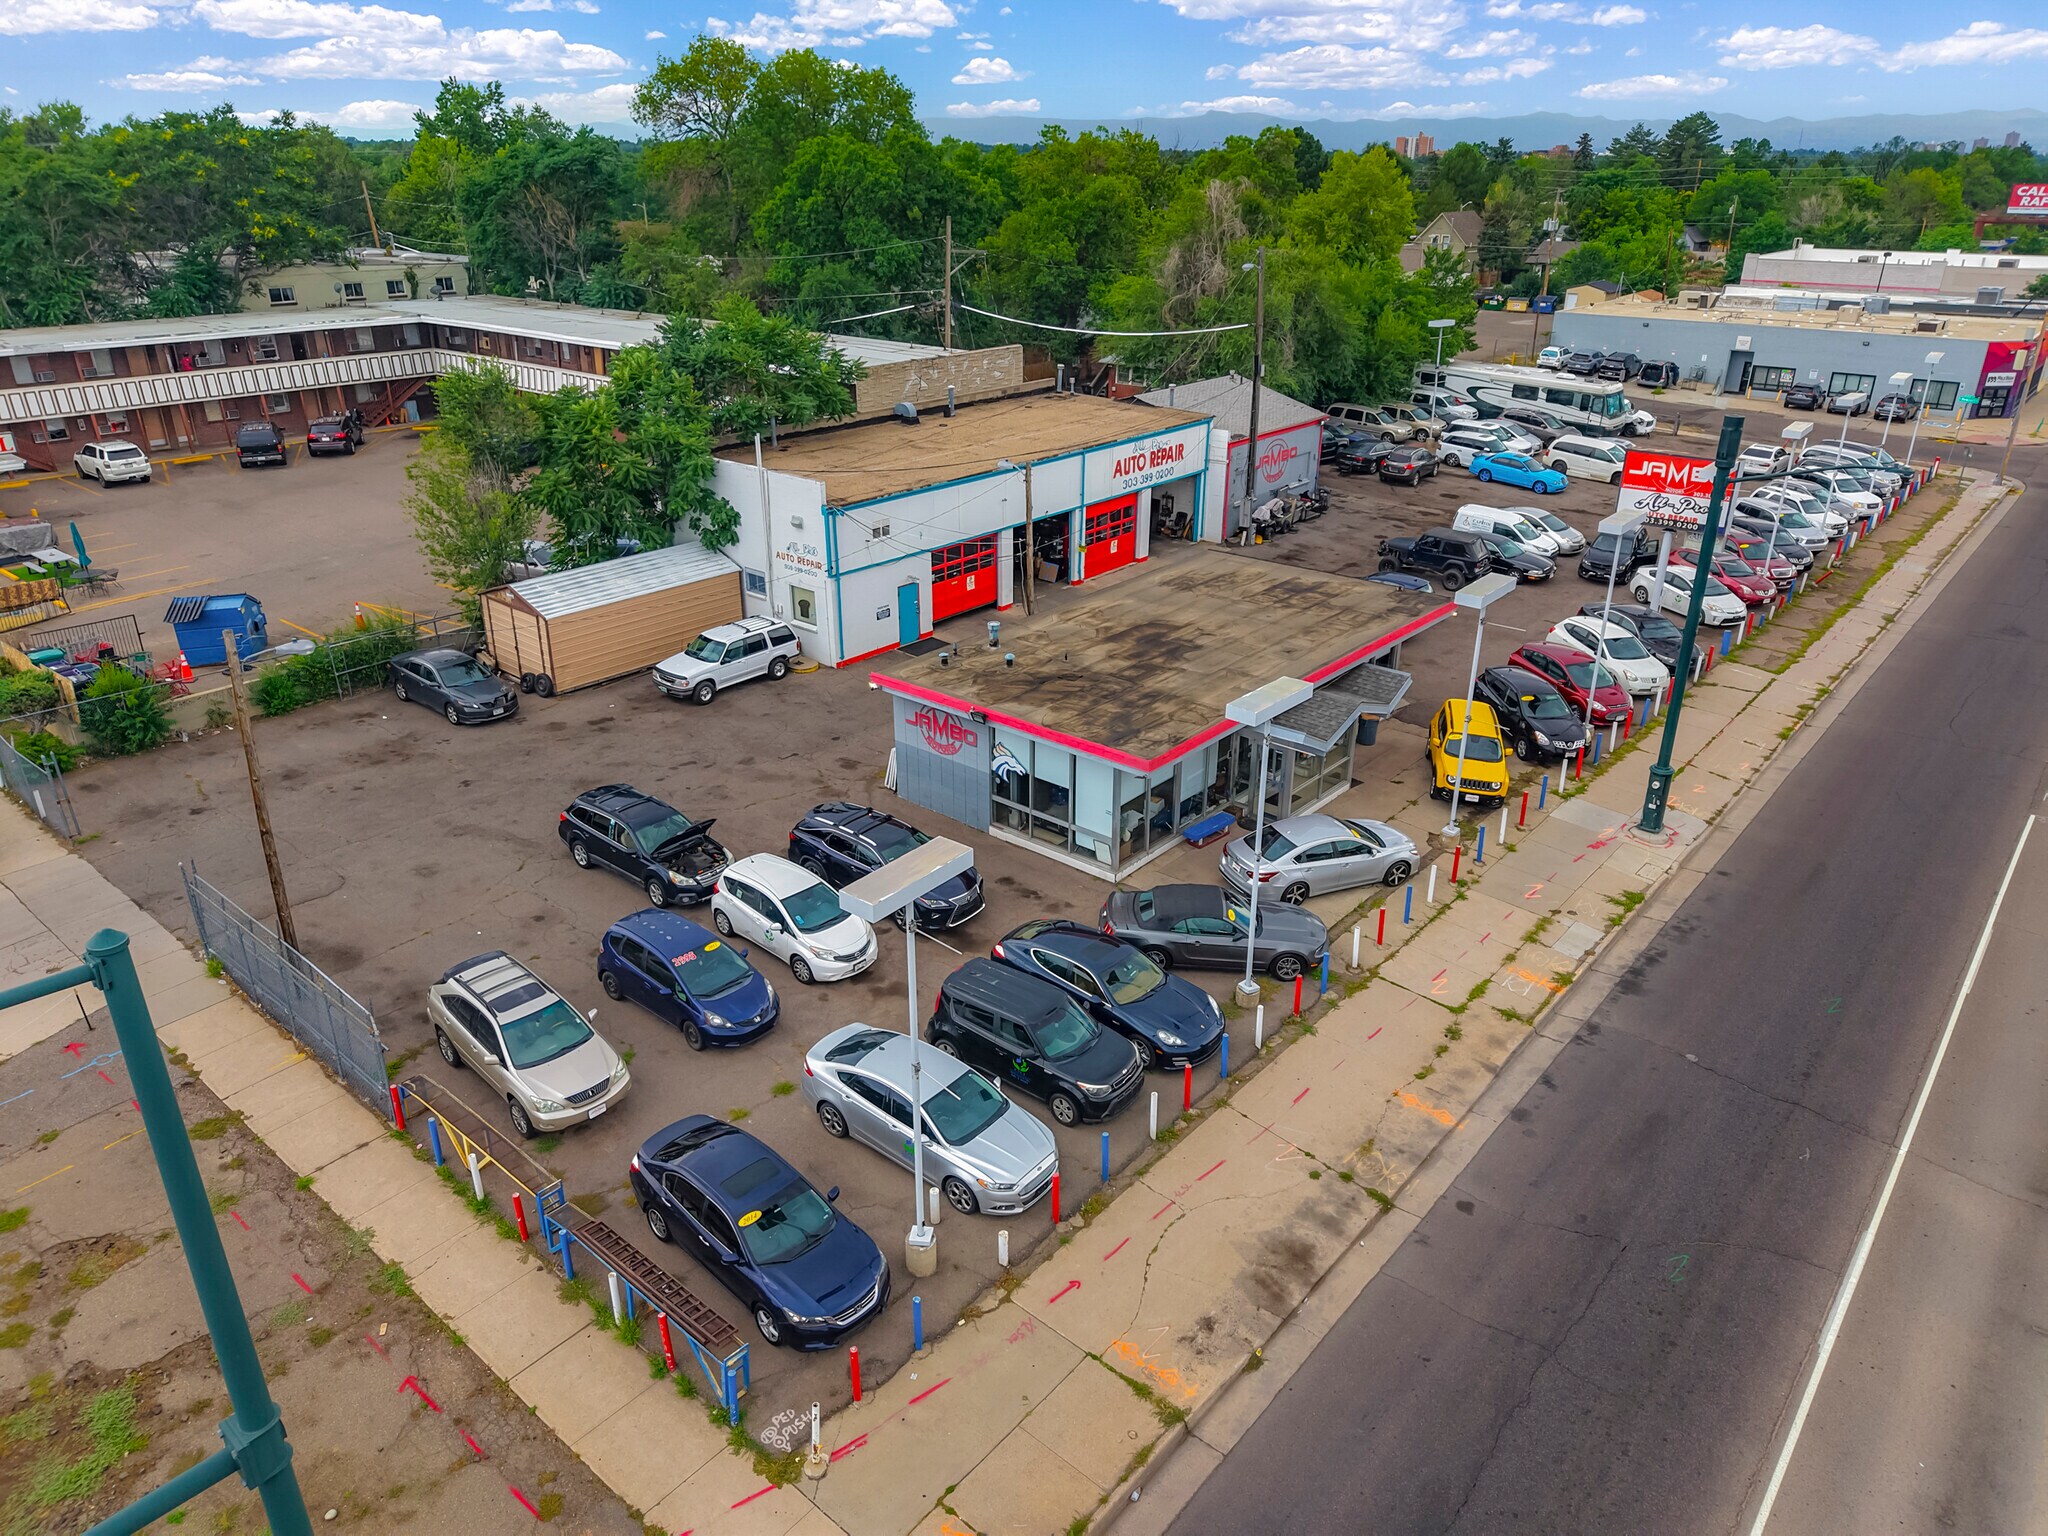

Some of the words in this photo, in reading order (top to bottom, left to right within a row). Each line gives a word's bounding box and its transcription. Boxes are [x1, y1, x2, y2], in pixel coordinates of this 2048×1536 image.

[1112, 453, 1147, 479] AUTO
[1149, 443, 1185, 469] REPAIR
[1253, 446, 1298, 474] JAMBO
[1629, 461, 1716, 488] JAMB
[1645, 518, 1699, 530] 03.399.0200
[1648, 511, 1666, 520] UTO
[1667, 514, 1699, 524] REPAIR
[776, 551, 795, 562] AUTO
[797, 556, 822, 570] REPAIR
[904, 708, 978, 748] JAMBO
[772, 1409, 796, 1429] PED
[781, 1410, 813, 1441] PUSH
